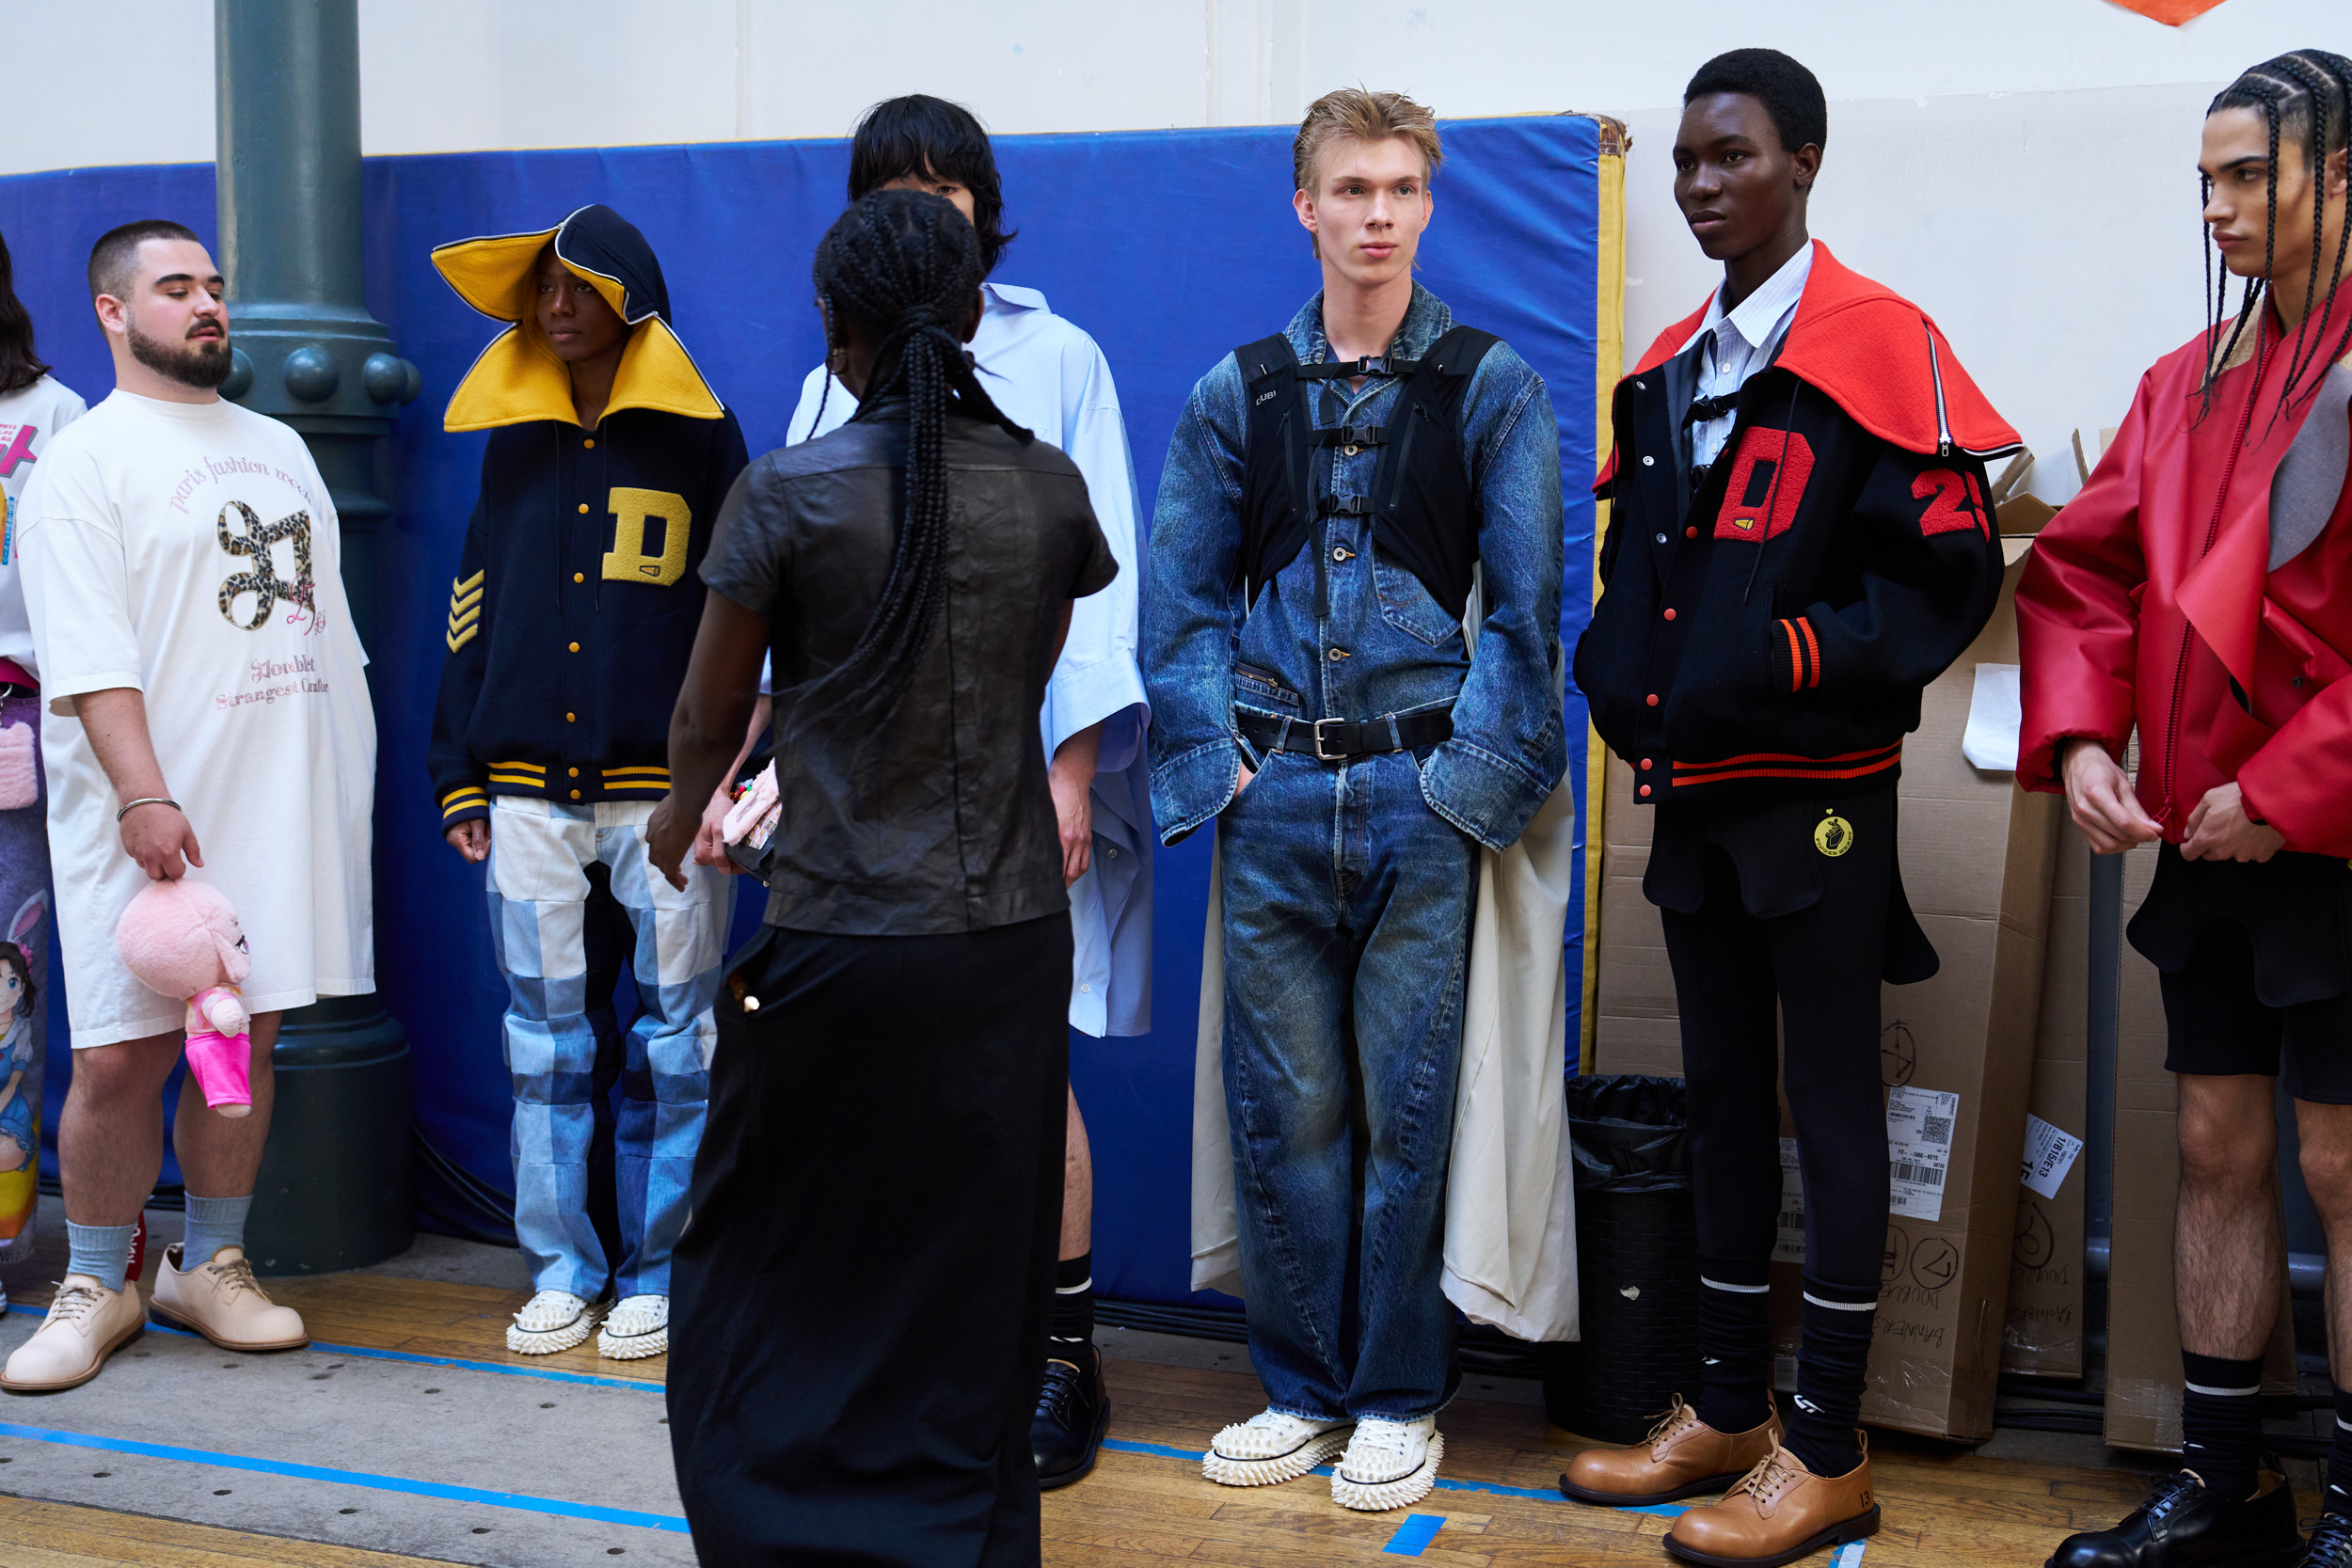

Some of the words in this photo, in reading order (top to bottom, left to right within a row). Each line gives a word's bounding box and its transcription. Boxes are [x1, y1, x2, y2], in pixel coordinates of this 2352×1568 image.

[168, 468, 208, 515] paris
[202, 455, 271, 485] fashion
[1713, 425, 1816, 544] D
[602, 486, 692, 587] D
[215, 680, 300, 711] Strangest
[2038, 1136, 2067, 1178] 1/B15/E13
[1872, 1314, 1946, 1349] BANNERS
[1859, 1490, 1870, 1508] 13
